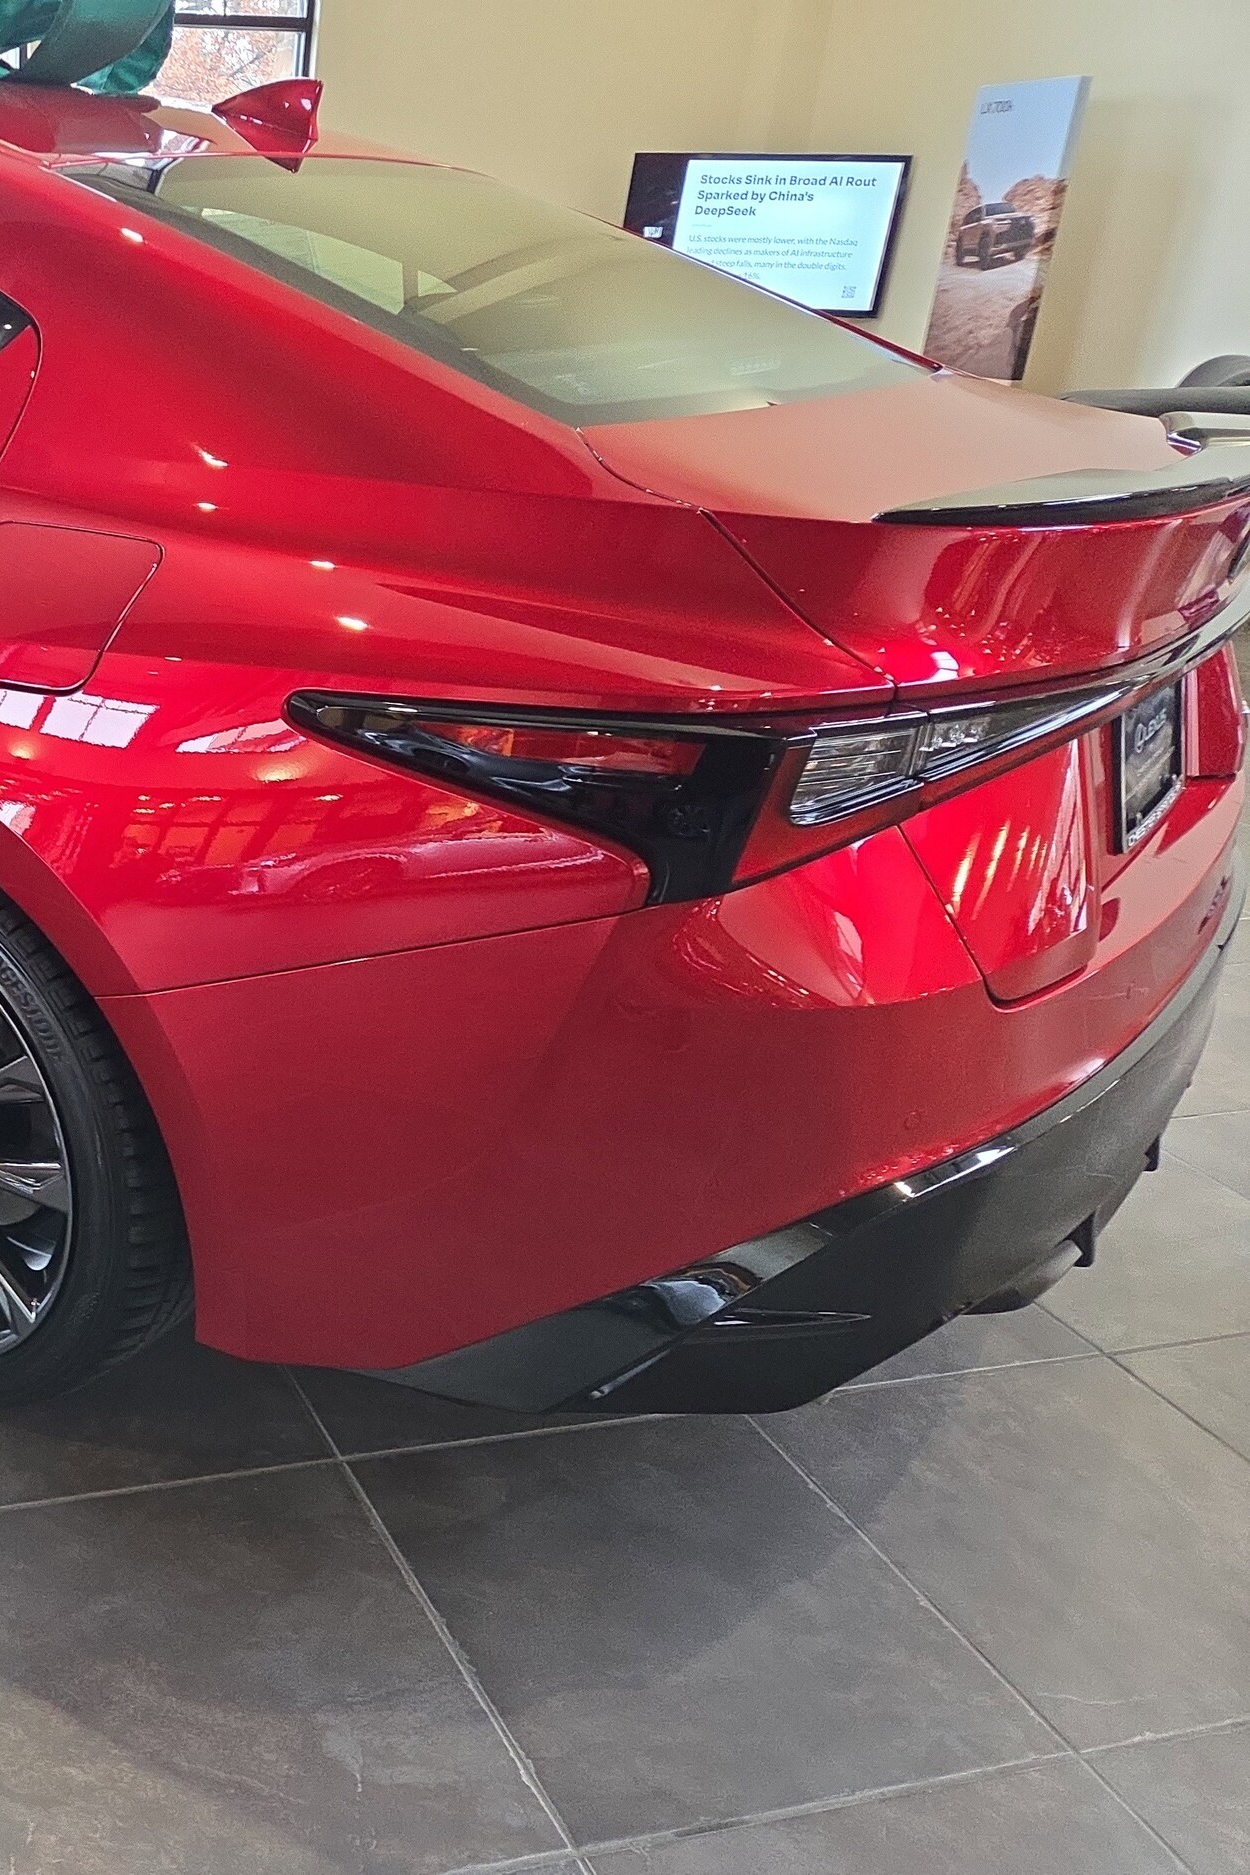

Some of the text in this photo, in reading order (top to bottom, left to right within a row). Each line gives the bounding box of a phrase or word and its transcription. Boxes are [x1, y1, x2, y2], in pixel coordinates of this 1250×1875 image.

[700, 174, 877, 187] Stocks Sink in Broad AI Rout
[697, 190, 814, 203] Sparked by China's
[694, 205, 757, 218] DeepSeek
[703, 235, 727, 243] stocks
[747, 236, 771, 245] mostly
[830, 238, 858, 247] Nasdaq
[713, 247, 743, 256] declines
[753, 248, 780, 257] makers
[781, 249, 789, 257] of
[800, 249, 853, 258] infrastructure
[753, 261, 774, 270] many
[783, 261, 796, 269] the
[797, 262, 823, 270] double
